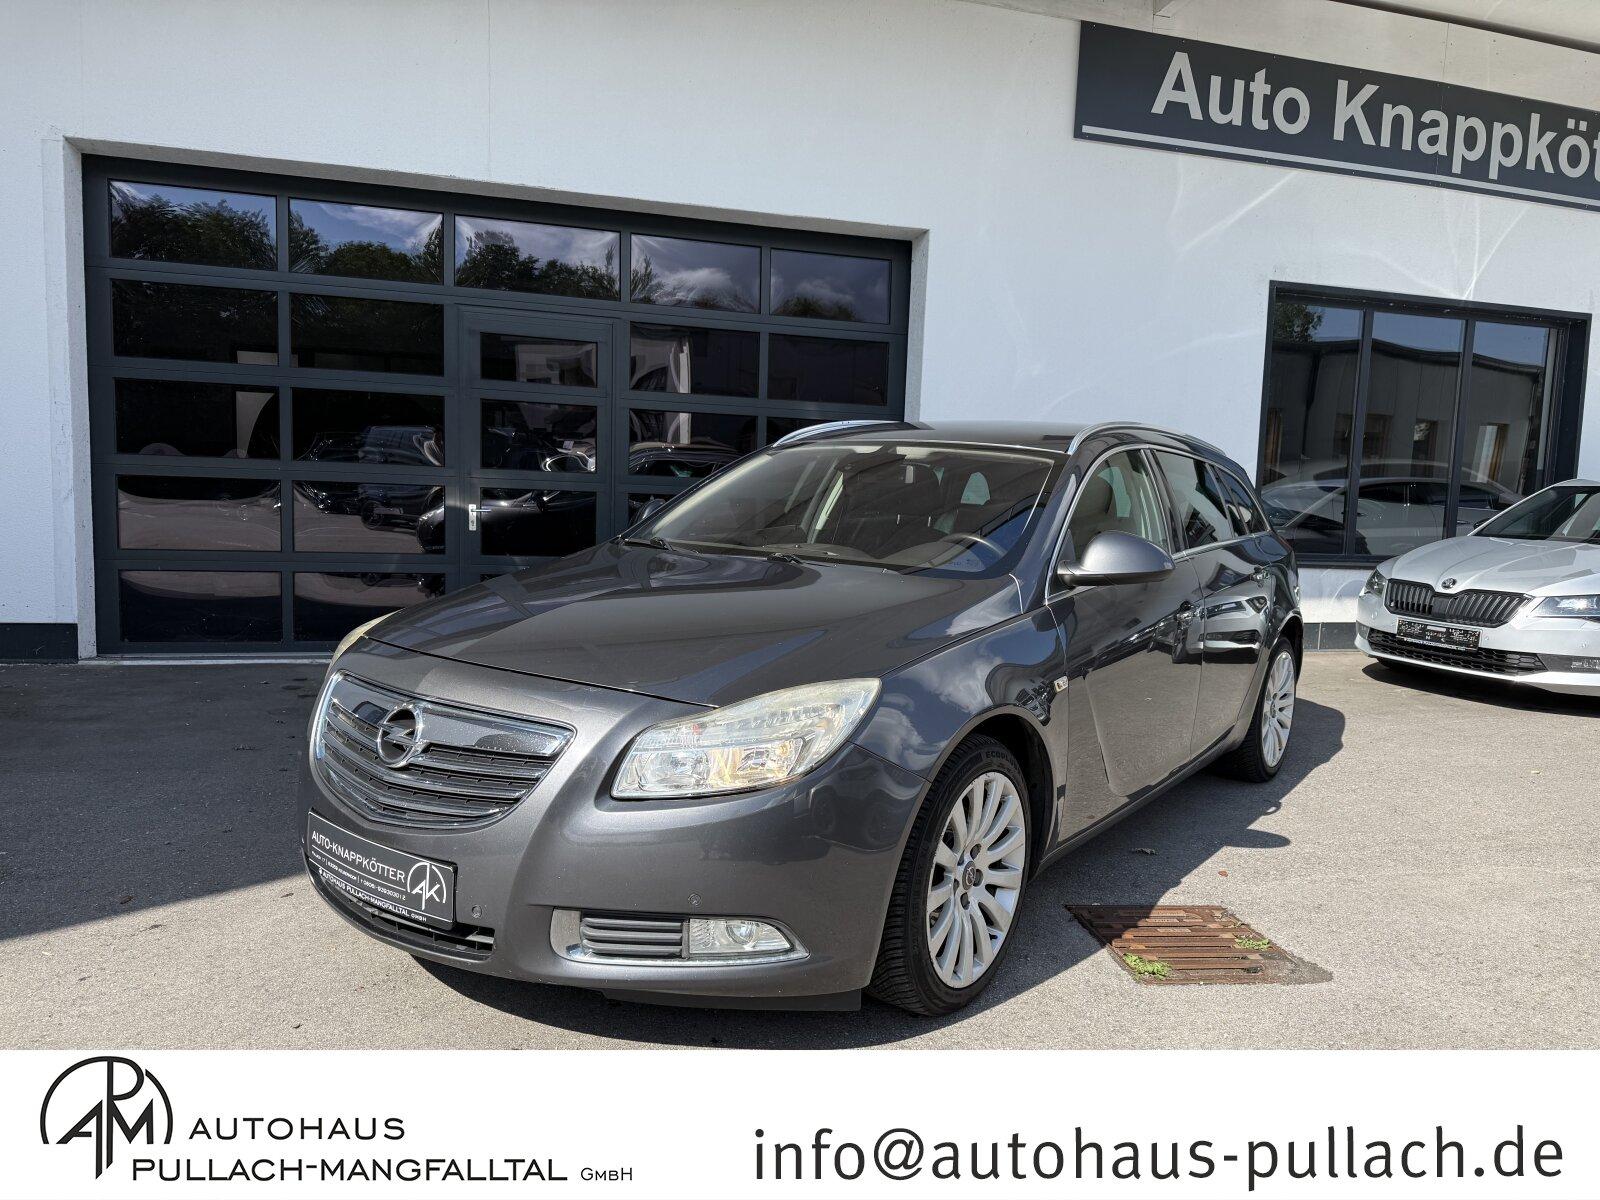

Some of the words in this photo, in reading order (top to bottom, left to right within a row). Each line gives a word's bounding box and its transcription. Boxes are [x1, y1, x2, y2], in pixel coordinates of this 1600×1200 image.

[1150, 51, 1310, 135] Auto
[311, 830, 405, 883] AUTO-KNAPPKÖTTER
[322, 871, 346, 890] AUTOHAUS
